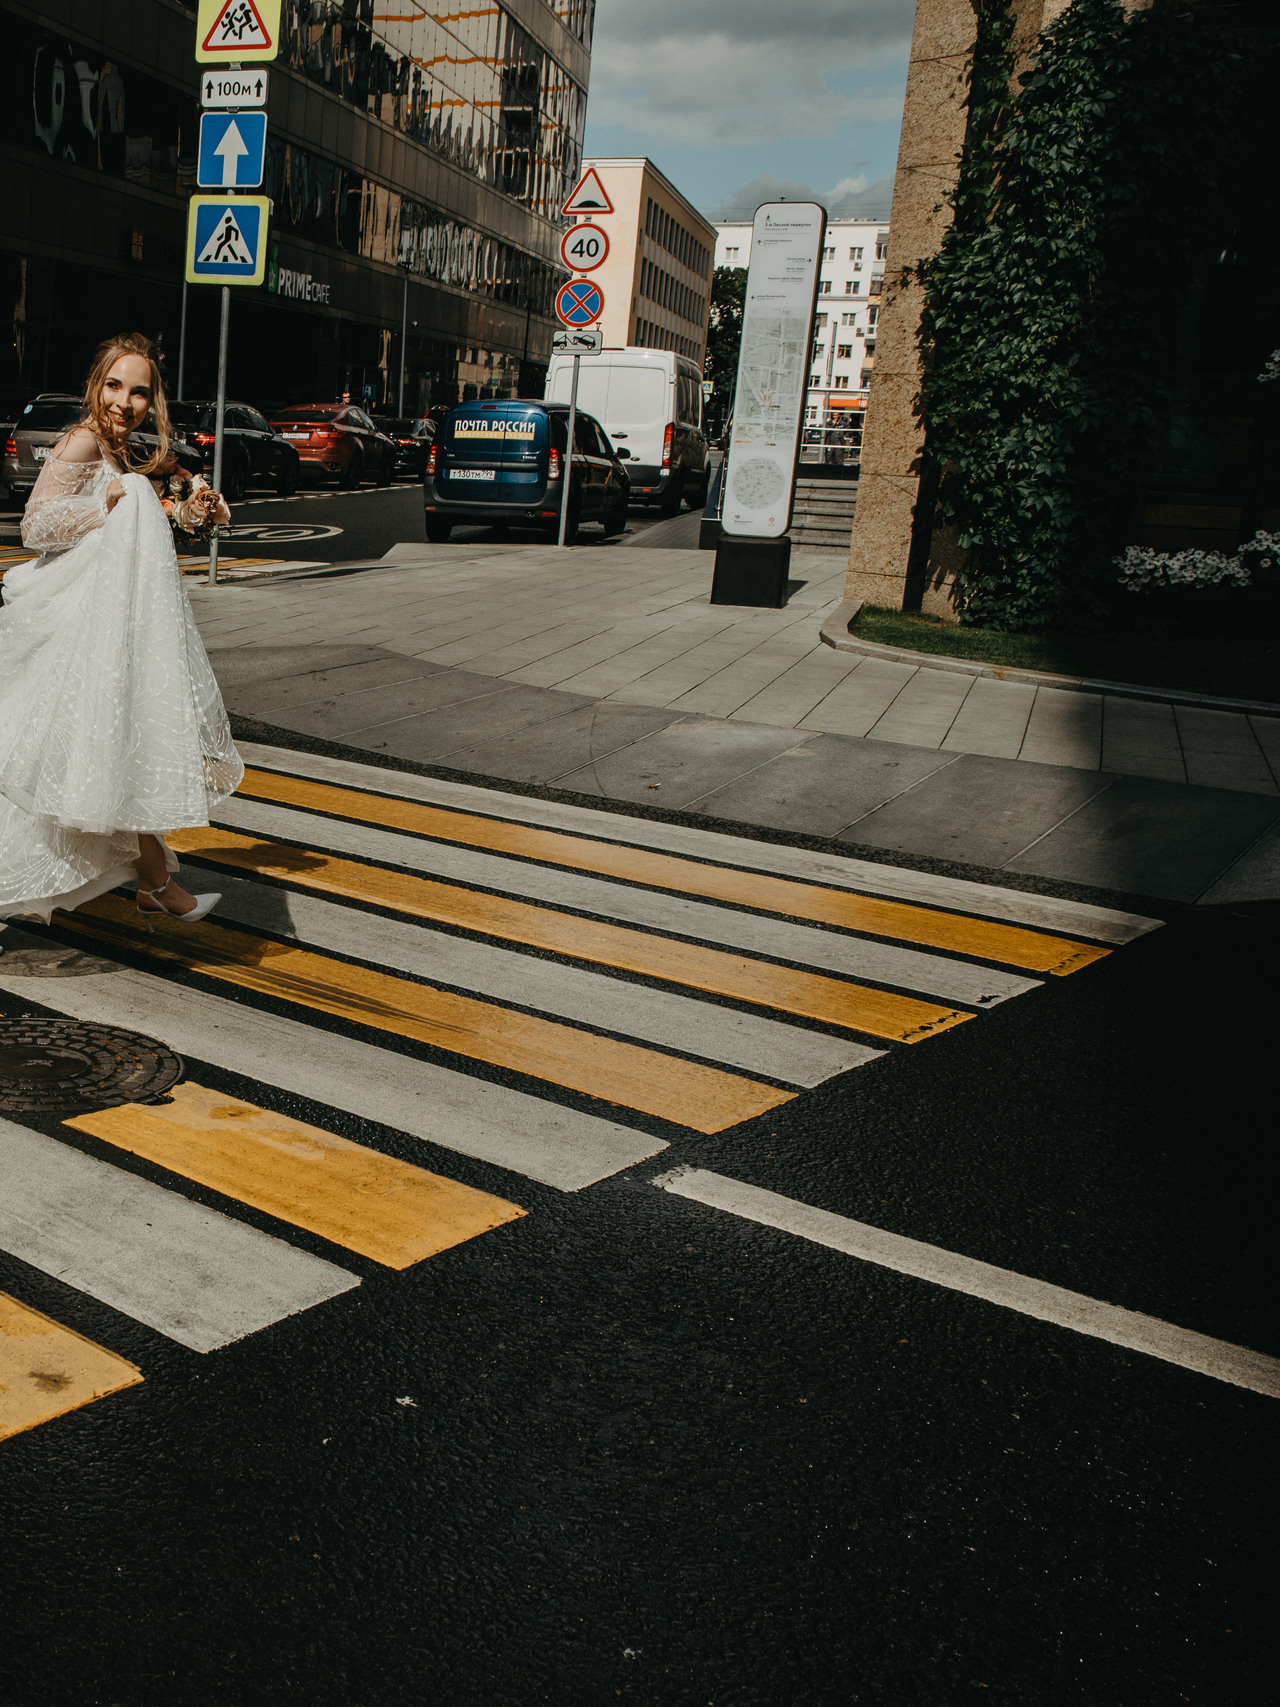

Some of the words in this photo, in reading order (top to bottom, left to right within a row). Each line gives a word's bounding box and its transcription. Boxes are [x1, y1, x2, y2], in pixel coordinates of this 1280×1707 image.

[570, 238, 600, 258] 40
[455, 420, 488, 431] ПОЧТА
[492, 420, 536, 433] РОССИИ
